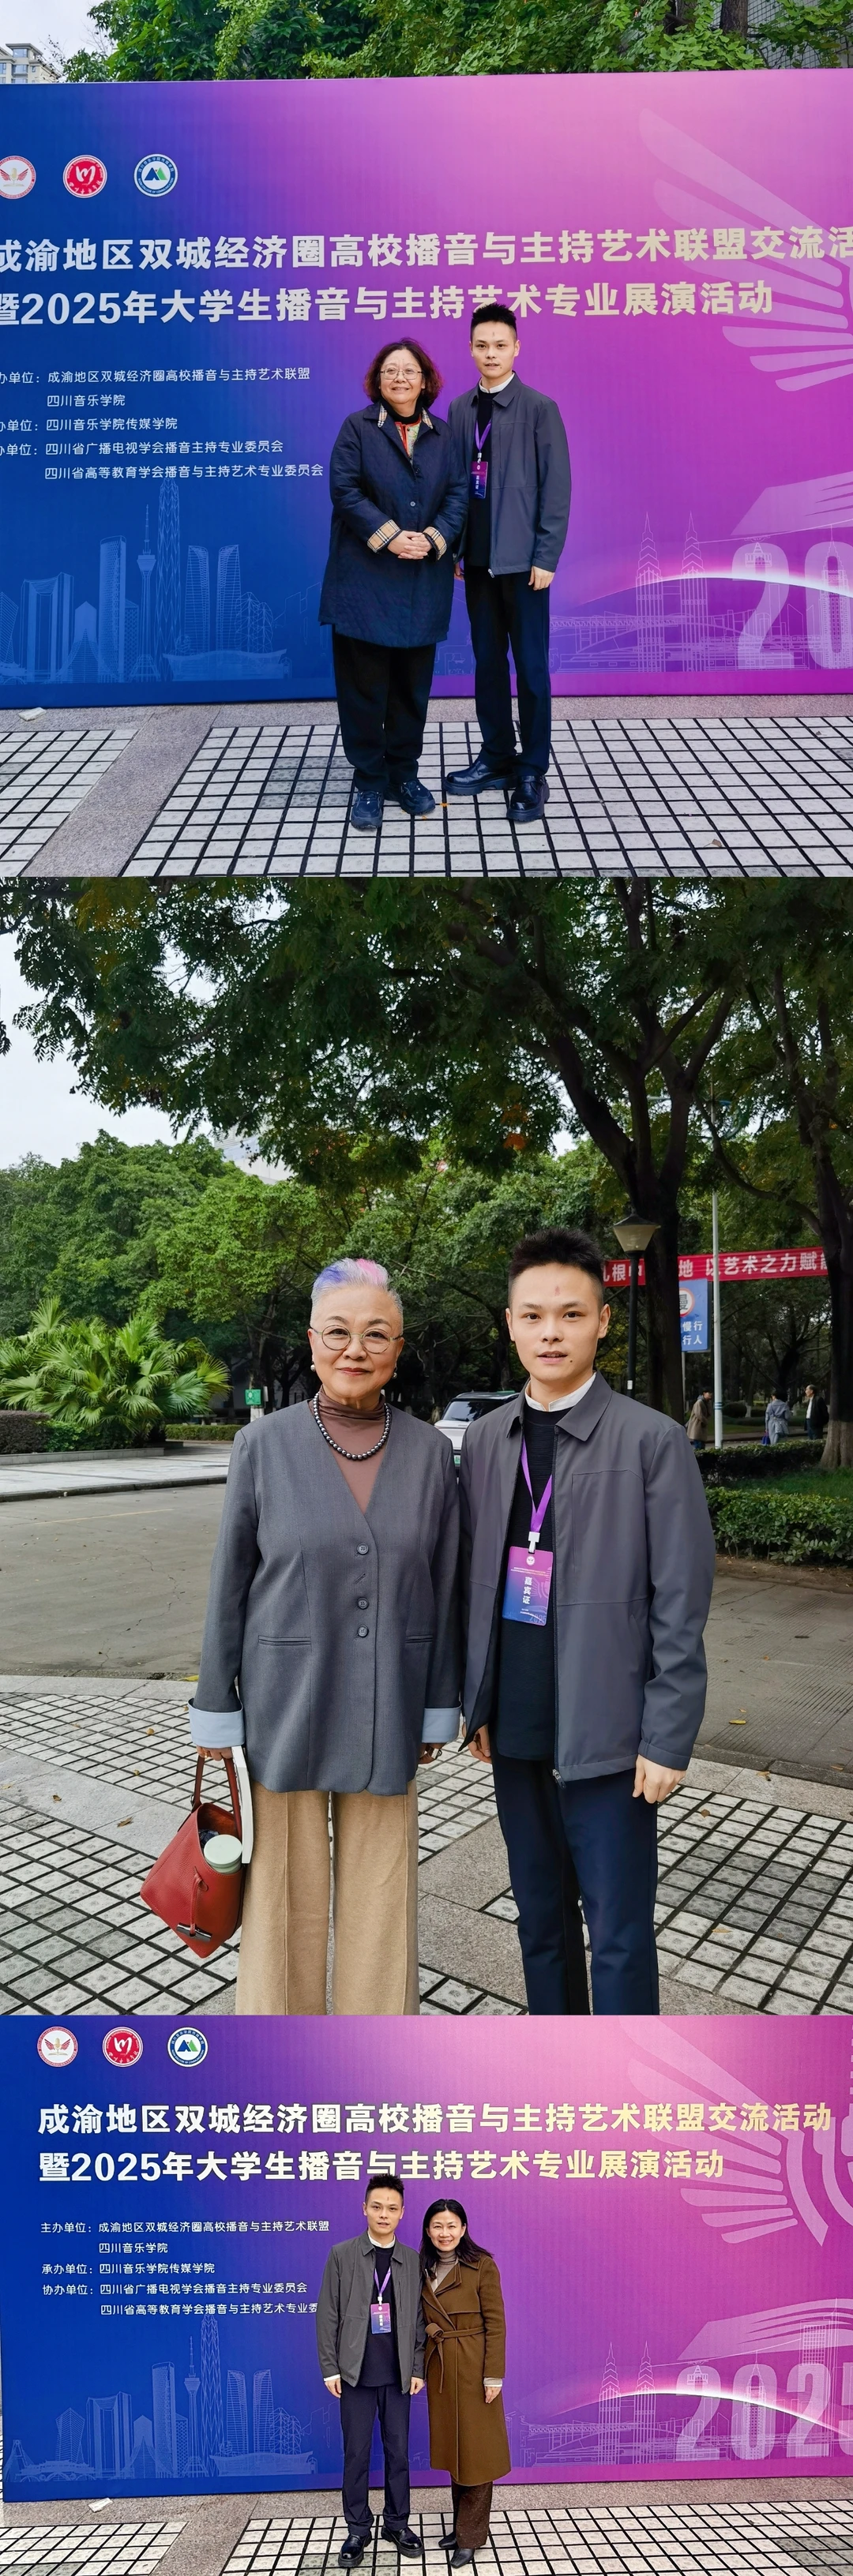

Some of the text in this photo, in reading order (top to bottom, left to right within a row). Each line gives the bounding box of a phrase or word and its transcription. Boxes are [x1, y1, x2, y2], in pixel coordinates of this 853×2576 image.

[48, 368, 310, 383] 成渝地区双城经济圈高校播音与主持艺术联盟
[47, 395, 125, 407] 四川音乐学院
[46, 418, 178, 431] 四川音乐学院传媒学院
[46, 440, 284, 456] 四川省广播电视学会播音主持专业委员会
[45, 463, 324, 479] 四川省高等教育学会播音与主持艺术专业委员会
[38, 2102, 832, 2134] 成渝地区双城经济圈高校播音与主持艺术联盟交流活动
[39, 2149, 723, 2181] 暨2025年大学生播音与主持艺术专业展演活动
[99, 2220, 329, 2233] 成渝地区双城经济圈高校播音与主持艺术联盟
[99, 2242, 168, 2253] 四川音乐学院
[100, 2263, 216, 2274] 四川音乐学院传媒学院
[100, 2282, 308, 2295] 四川省广播电视学会播音主持专业委员会
